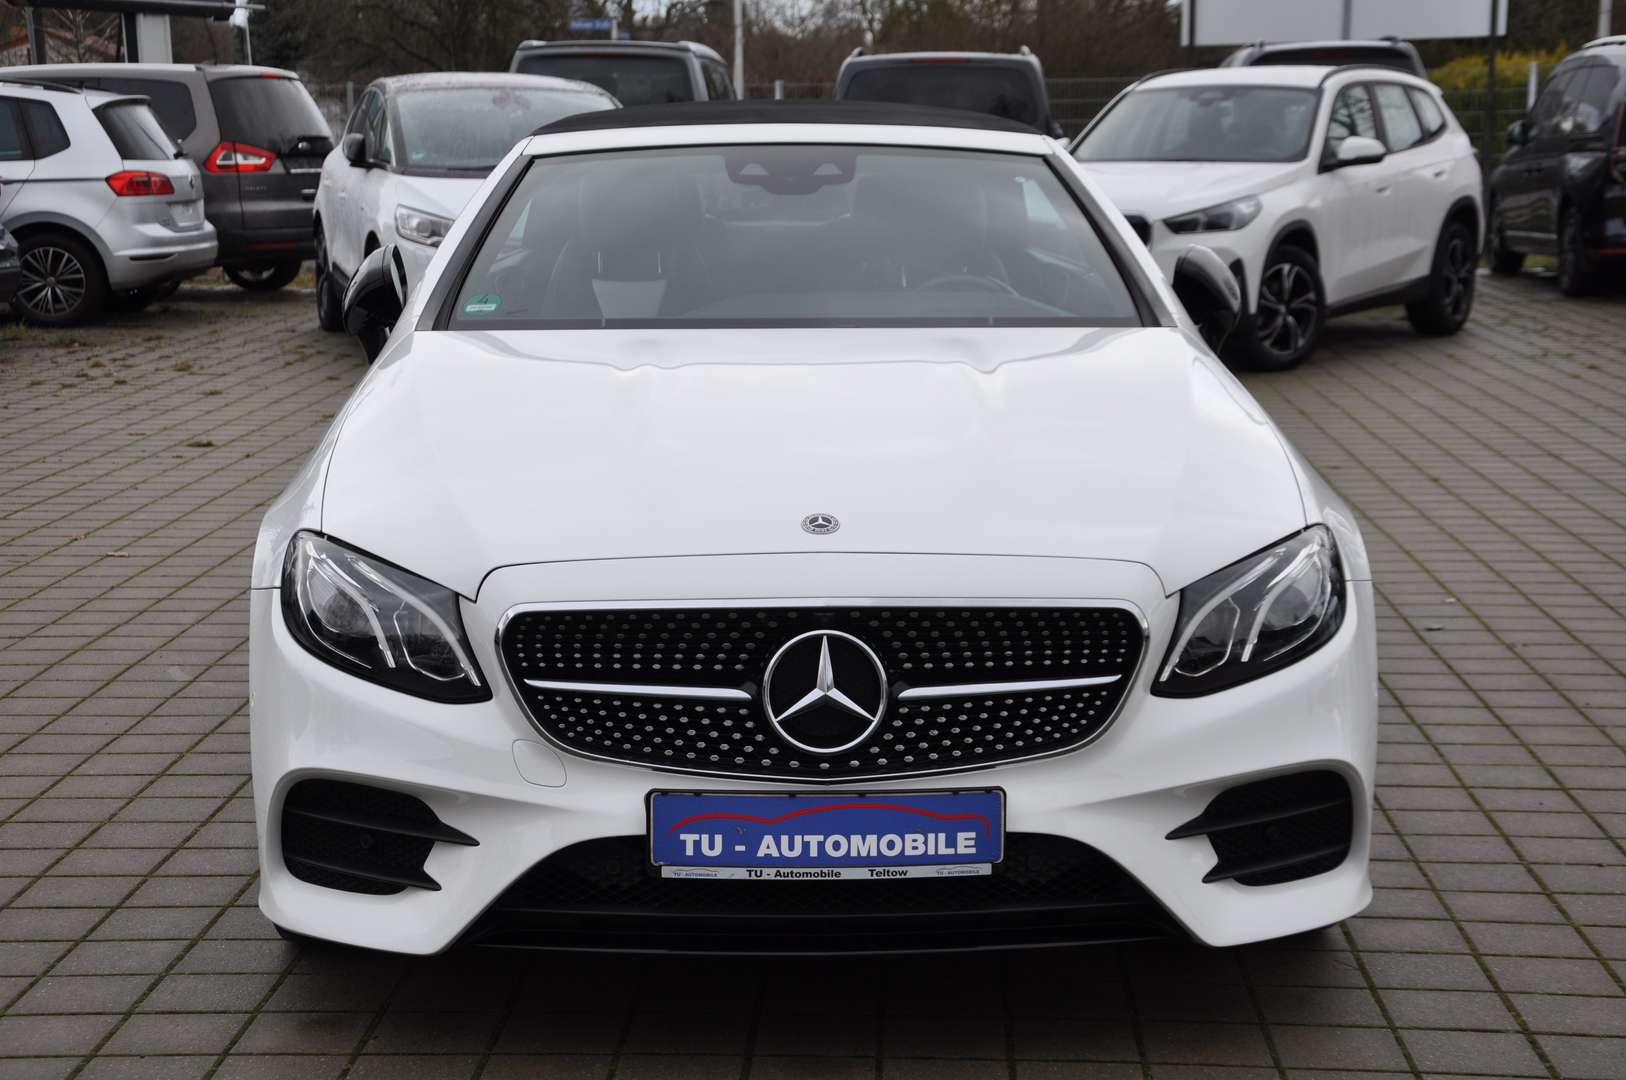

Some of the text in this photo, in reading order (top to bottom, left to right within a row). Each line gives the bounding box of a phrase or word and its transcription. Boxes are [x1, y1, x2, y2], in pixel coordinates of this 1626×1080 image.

[679, 834, 722, 856] TU
[757, 832, 976, 857] AUTOMOBILE
[746, 869, 763, 878] TU
[774, 869, 841, 878] Automobile
[868, 868, 908, 878] Teltow
